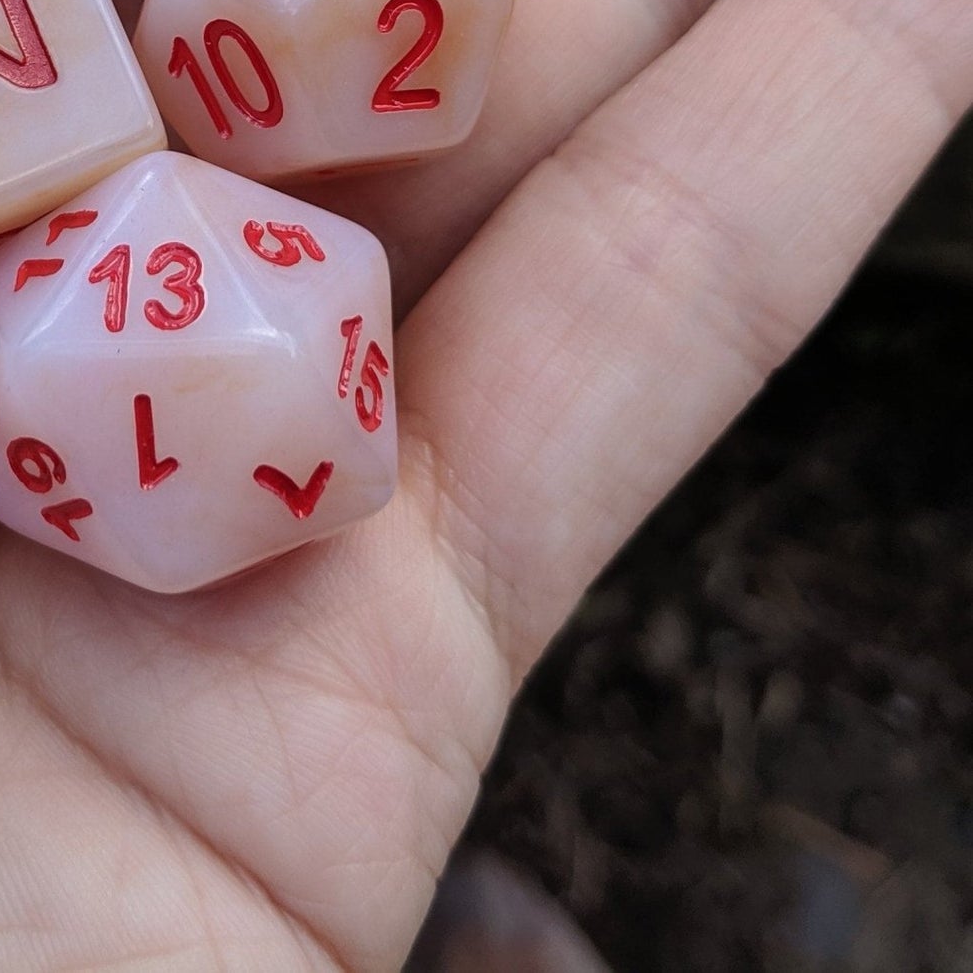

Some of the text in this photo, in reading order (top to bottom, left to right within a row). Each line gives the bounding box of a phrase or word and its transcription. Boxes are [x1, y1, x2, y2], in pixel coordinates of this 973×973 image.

[167, 18, 285, 141] 10
[88, 241, 206, 333] 13
[242, 219, 326, 268] 5
[337, 314, 390, 433] 15
[133, 393, 180, 491] 1
